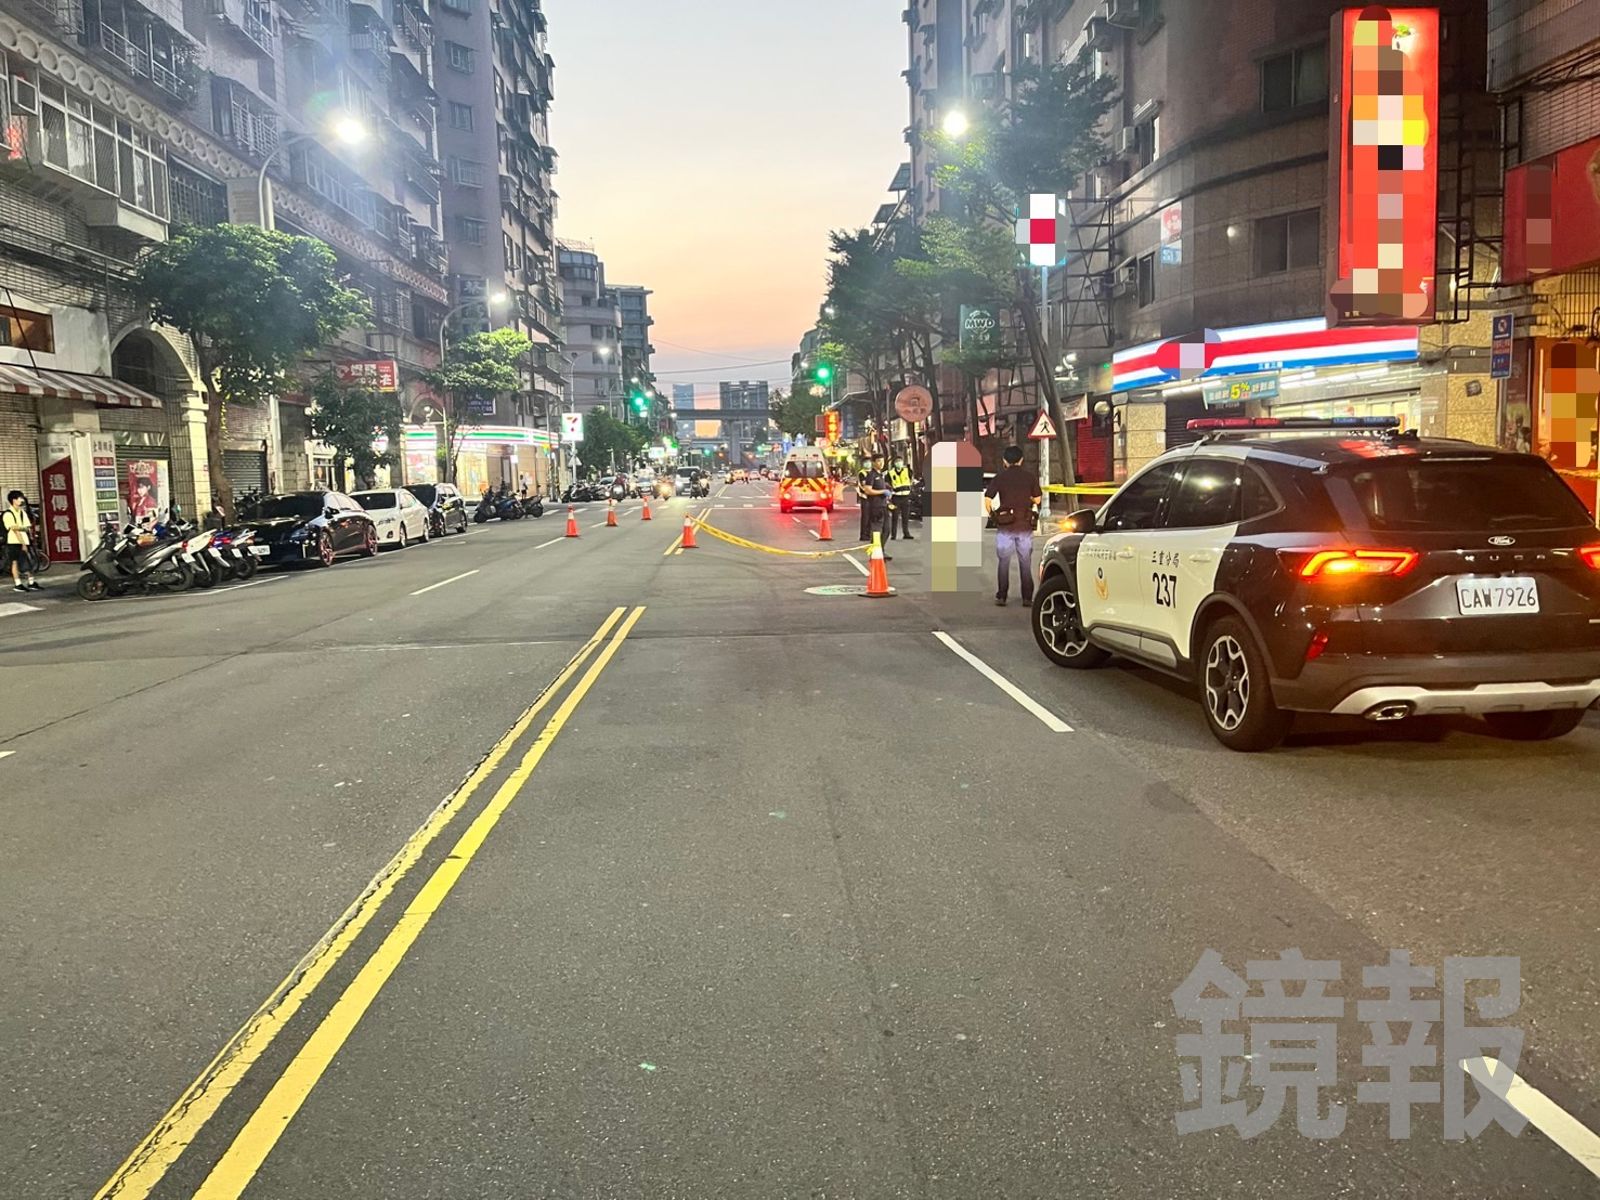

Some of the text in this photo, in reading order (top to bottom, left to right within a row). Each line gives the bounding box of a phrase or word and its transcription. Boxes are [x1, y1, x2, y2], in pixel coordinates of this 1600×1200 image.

[965, 318, 995, 329] MWD
[50, 473, 72, 552] 遠傳電信
[1152, 551, 1179, 568] 三重分局
[1152, 572, 1177, 609] 237
